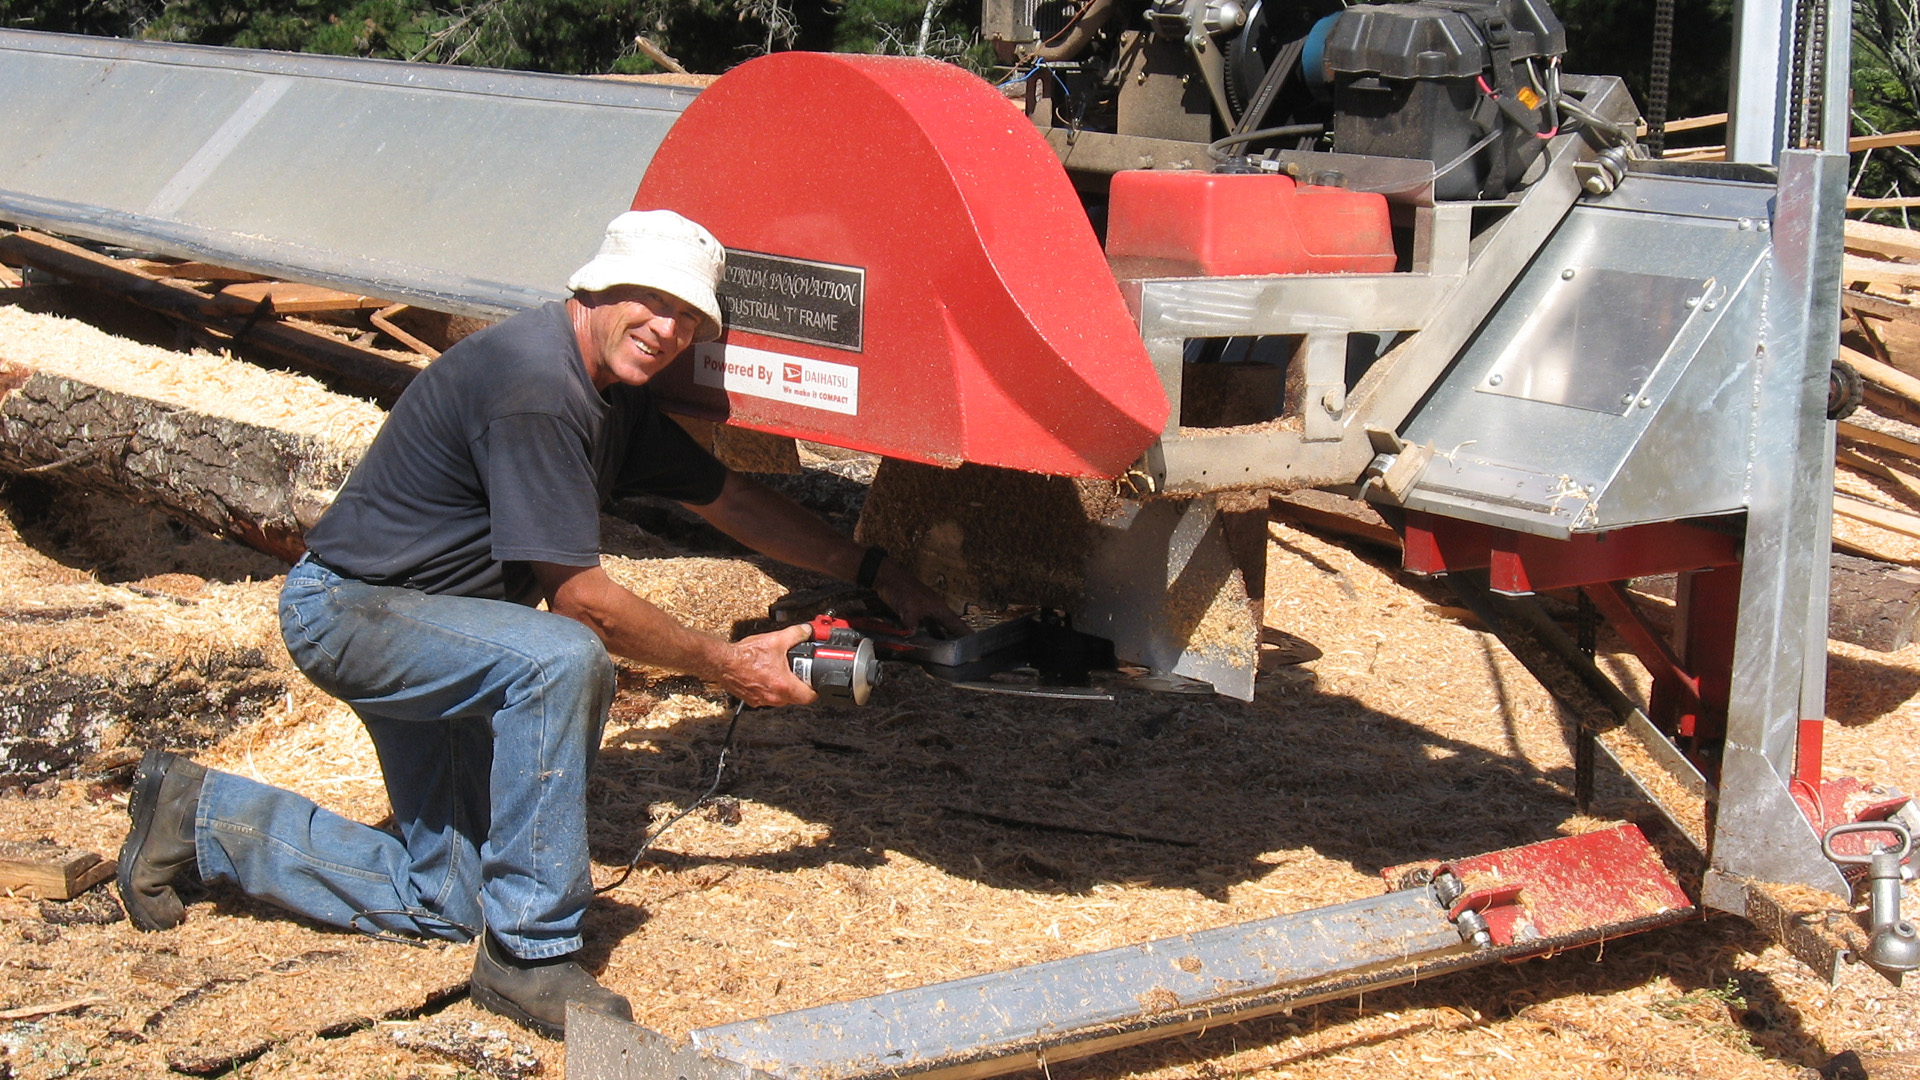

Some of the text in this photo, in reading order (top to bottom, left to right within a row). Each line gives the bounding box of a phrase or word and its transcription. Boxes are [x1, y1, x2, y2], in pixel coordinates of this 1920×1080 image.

[723, 265, 857, 306] CTRUM INNOVATION
[799, 309, 838, 331] FRAME
[704, 355, 773, 385] Powered By
[804, 370, 848, 389] DAIHATSU
[783, 385, 792, 394] We
[794, 389, 811, 398] make
[819, 392, 849, 404] COMPACT
